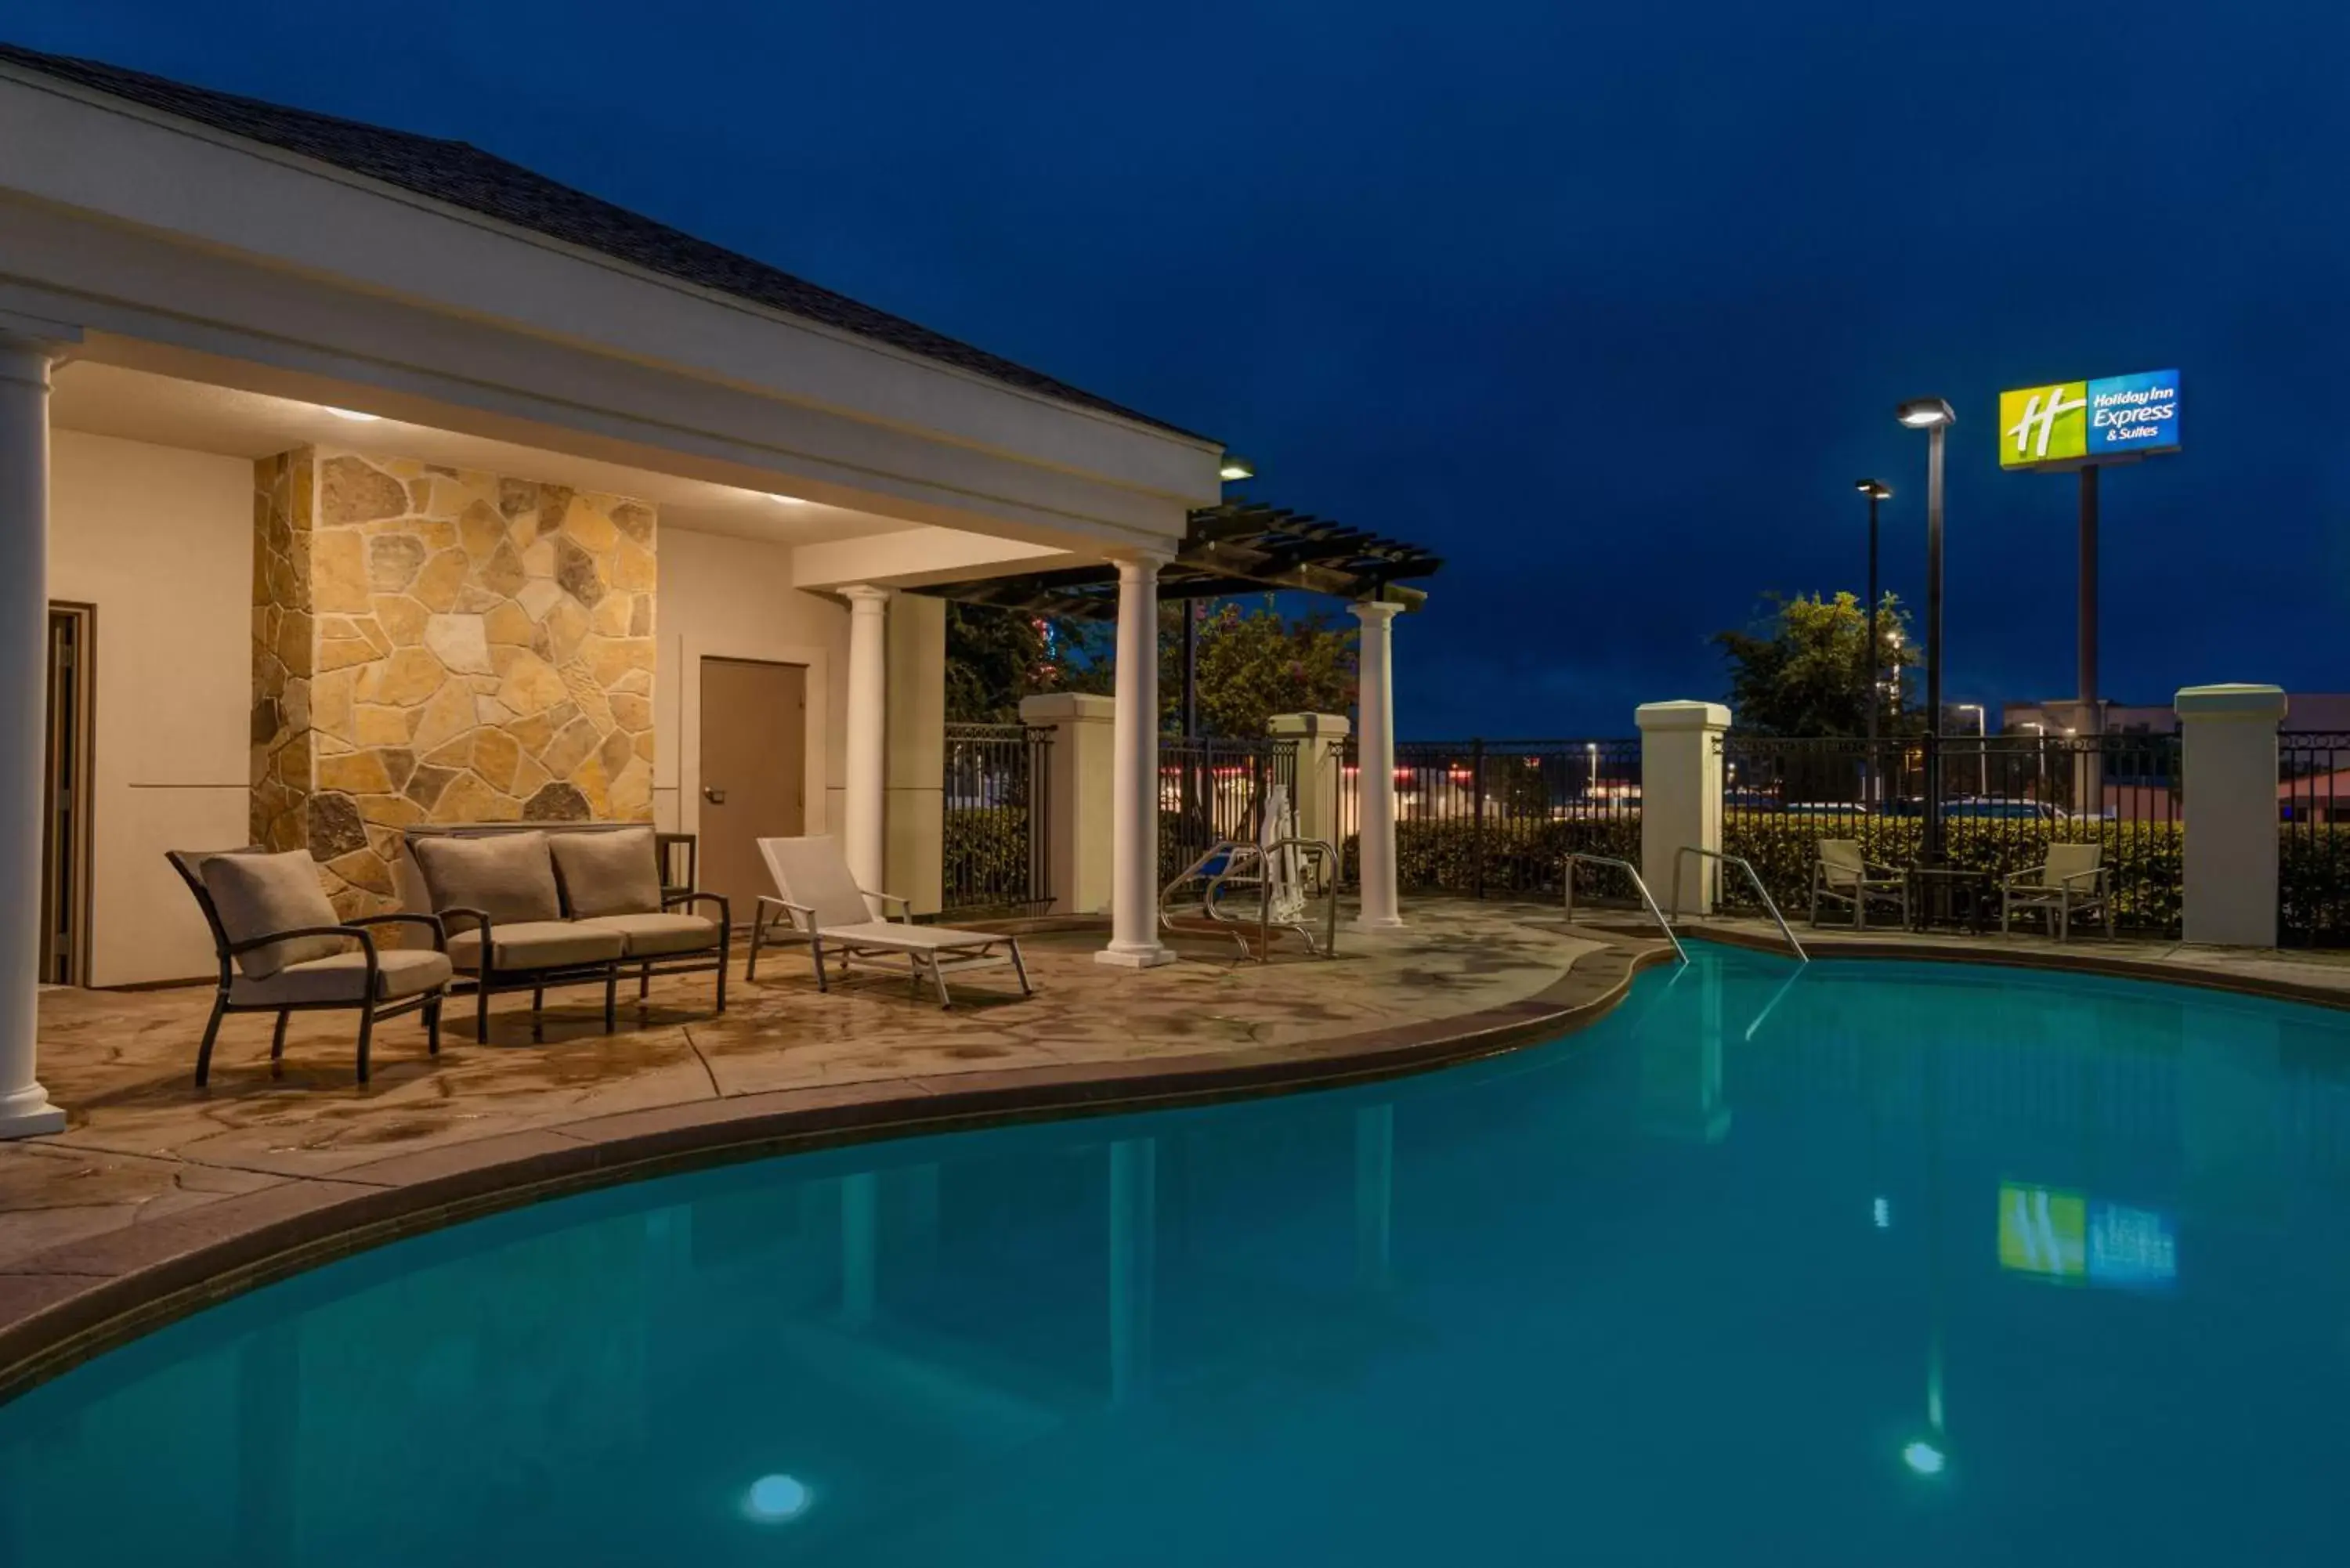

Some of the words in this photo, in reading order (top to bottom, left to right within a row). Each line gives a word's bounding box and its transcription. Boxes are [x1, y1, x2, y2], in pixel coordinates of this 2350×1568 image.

[2094, 391, 2149, 407] Holiday
[2149, 387, 2174, 400] Inn
[2094, 405, 2174, 427] Express
[2107, 430, 2117, 441] &
[2120, 426, 2158, 439] Suites
